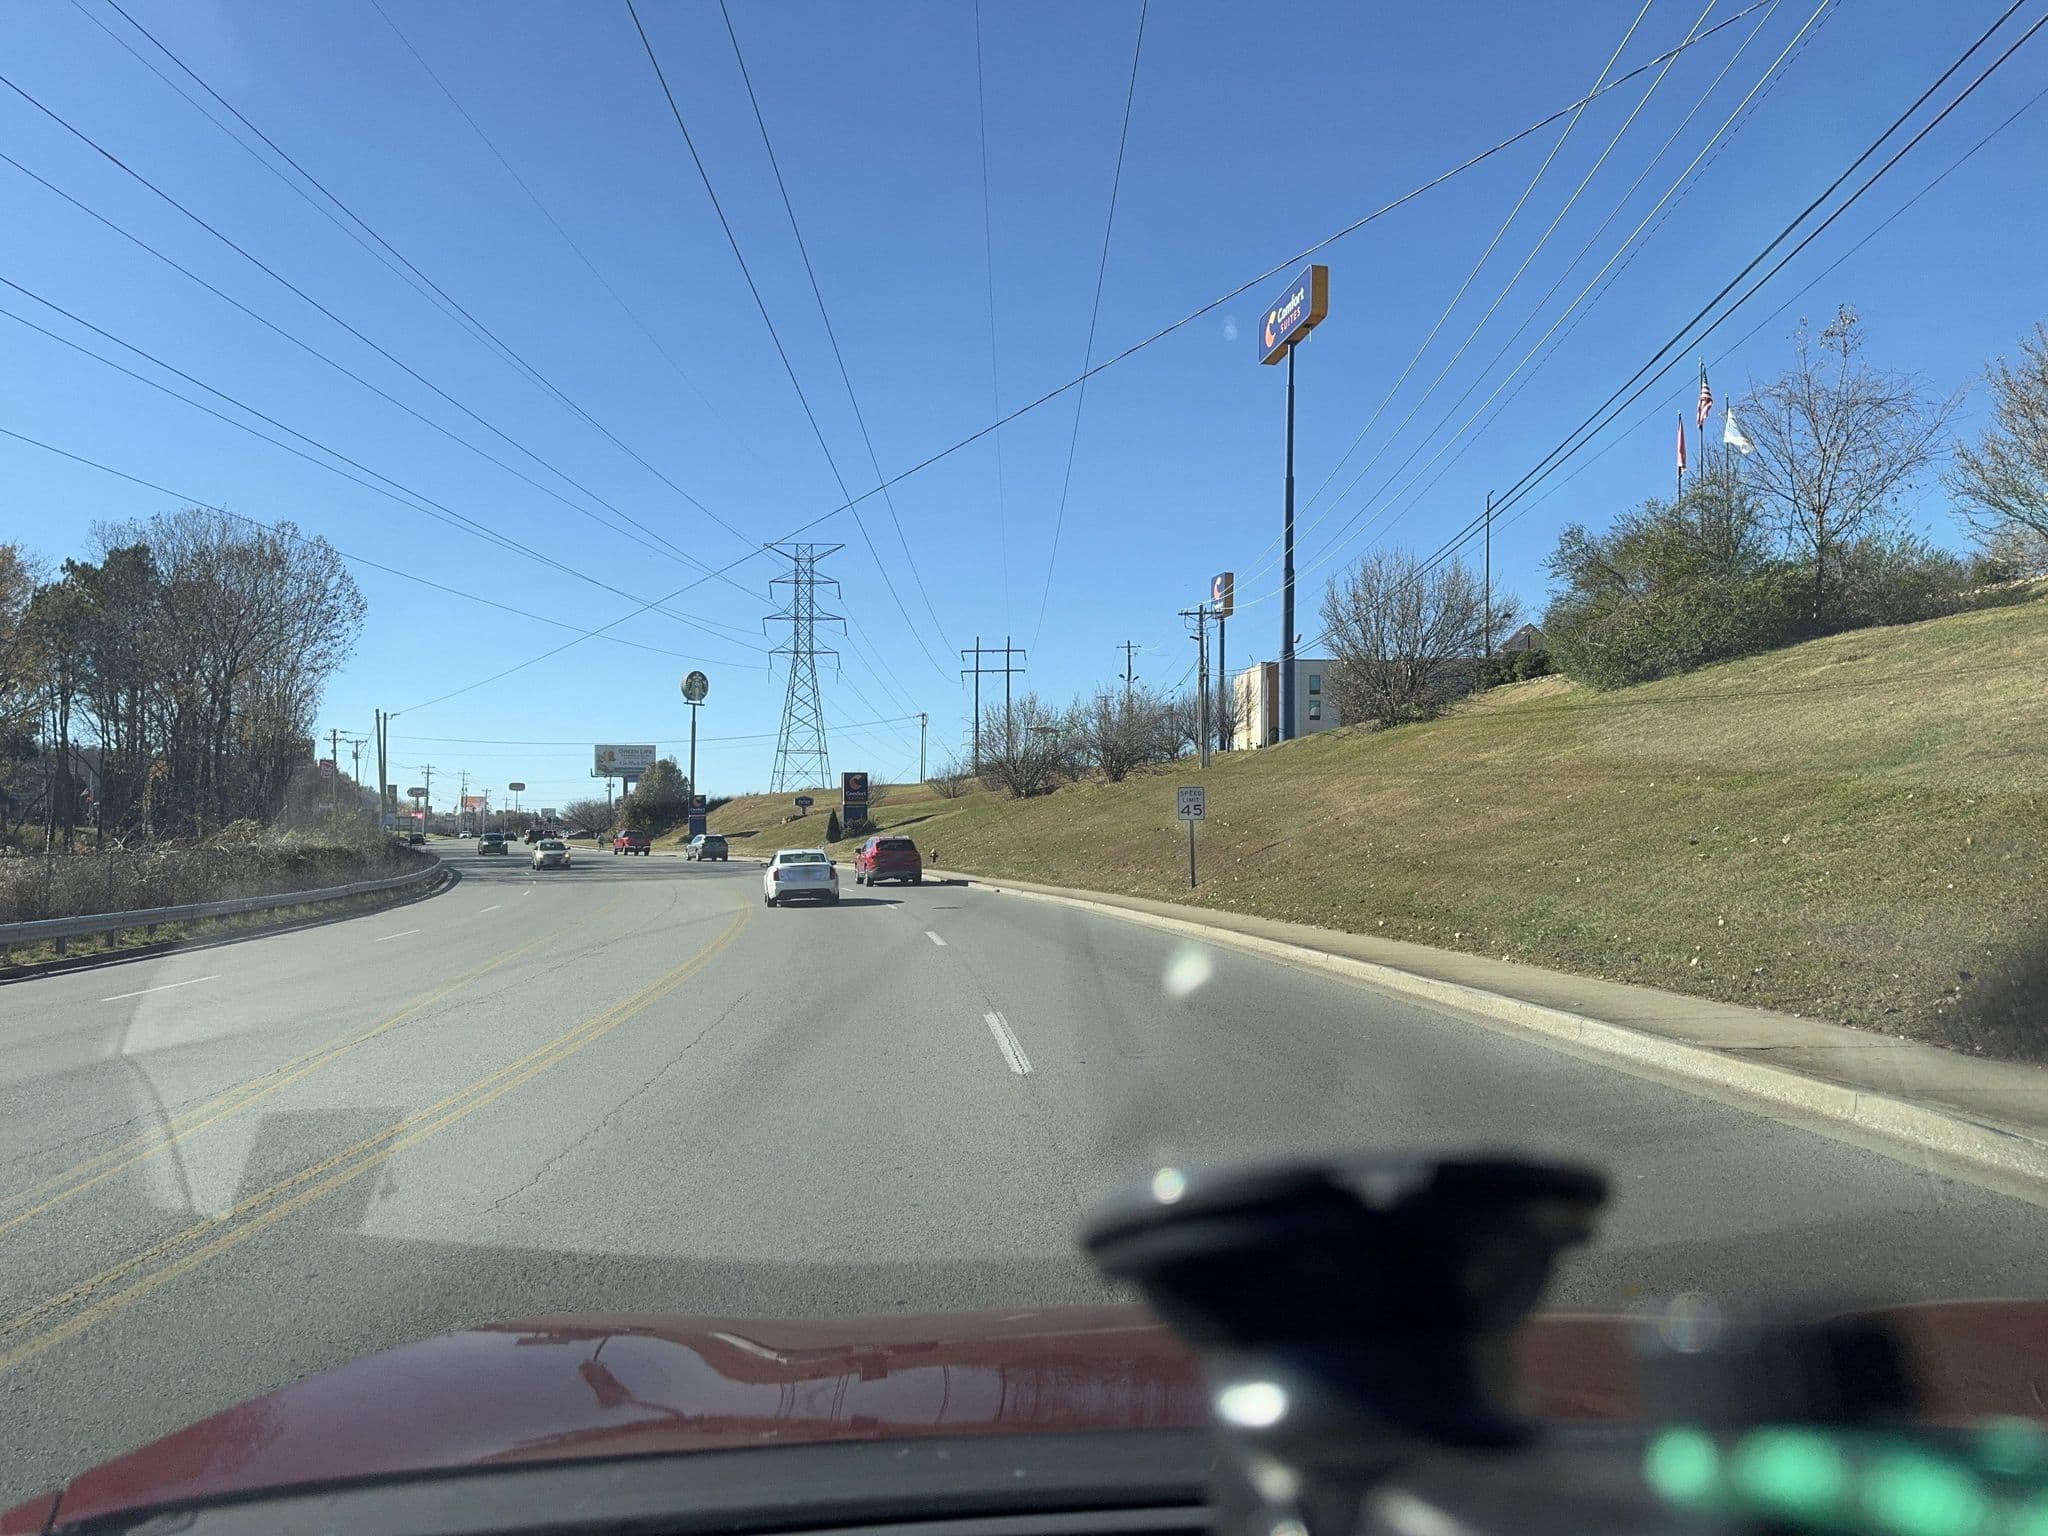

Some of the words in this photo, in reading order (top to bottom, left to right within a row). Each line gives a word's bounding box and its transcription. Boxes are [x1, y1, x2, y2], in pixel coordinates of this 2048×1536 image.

[1277, 287, 1305, 323] Comfort
[1280, 307, 1301, 334] SUITES
[1180, 804, 1203, 817] 45
